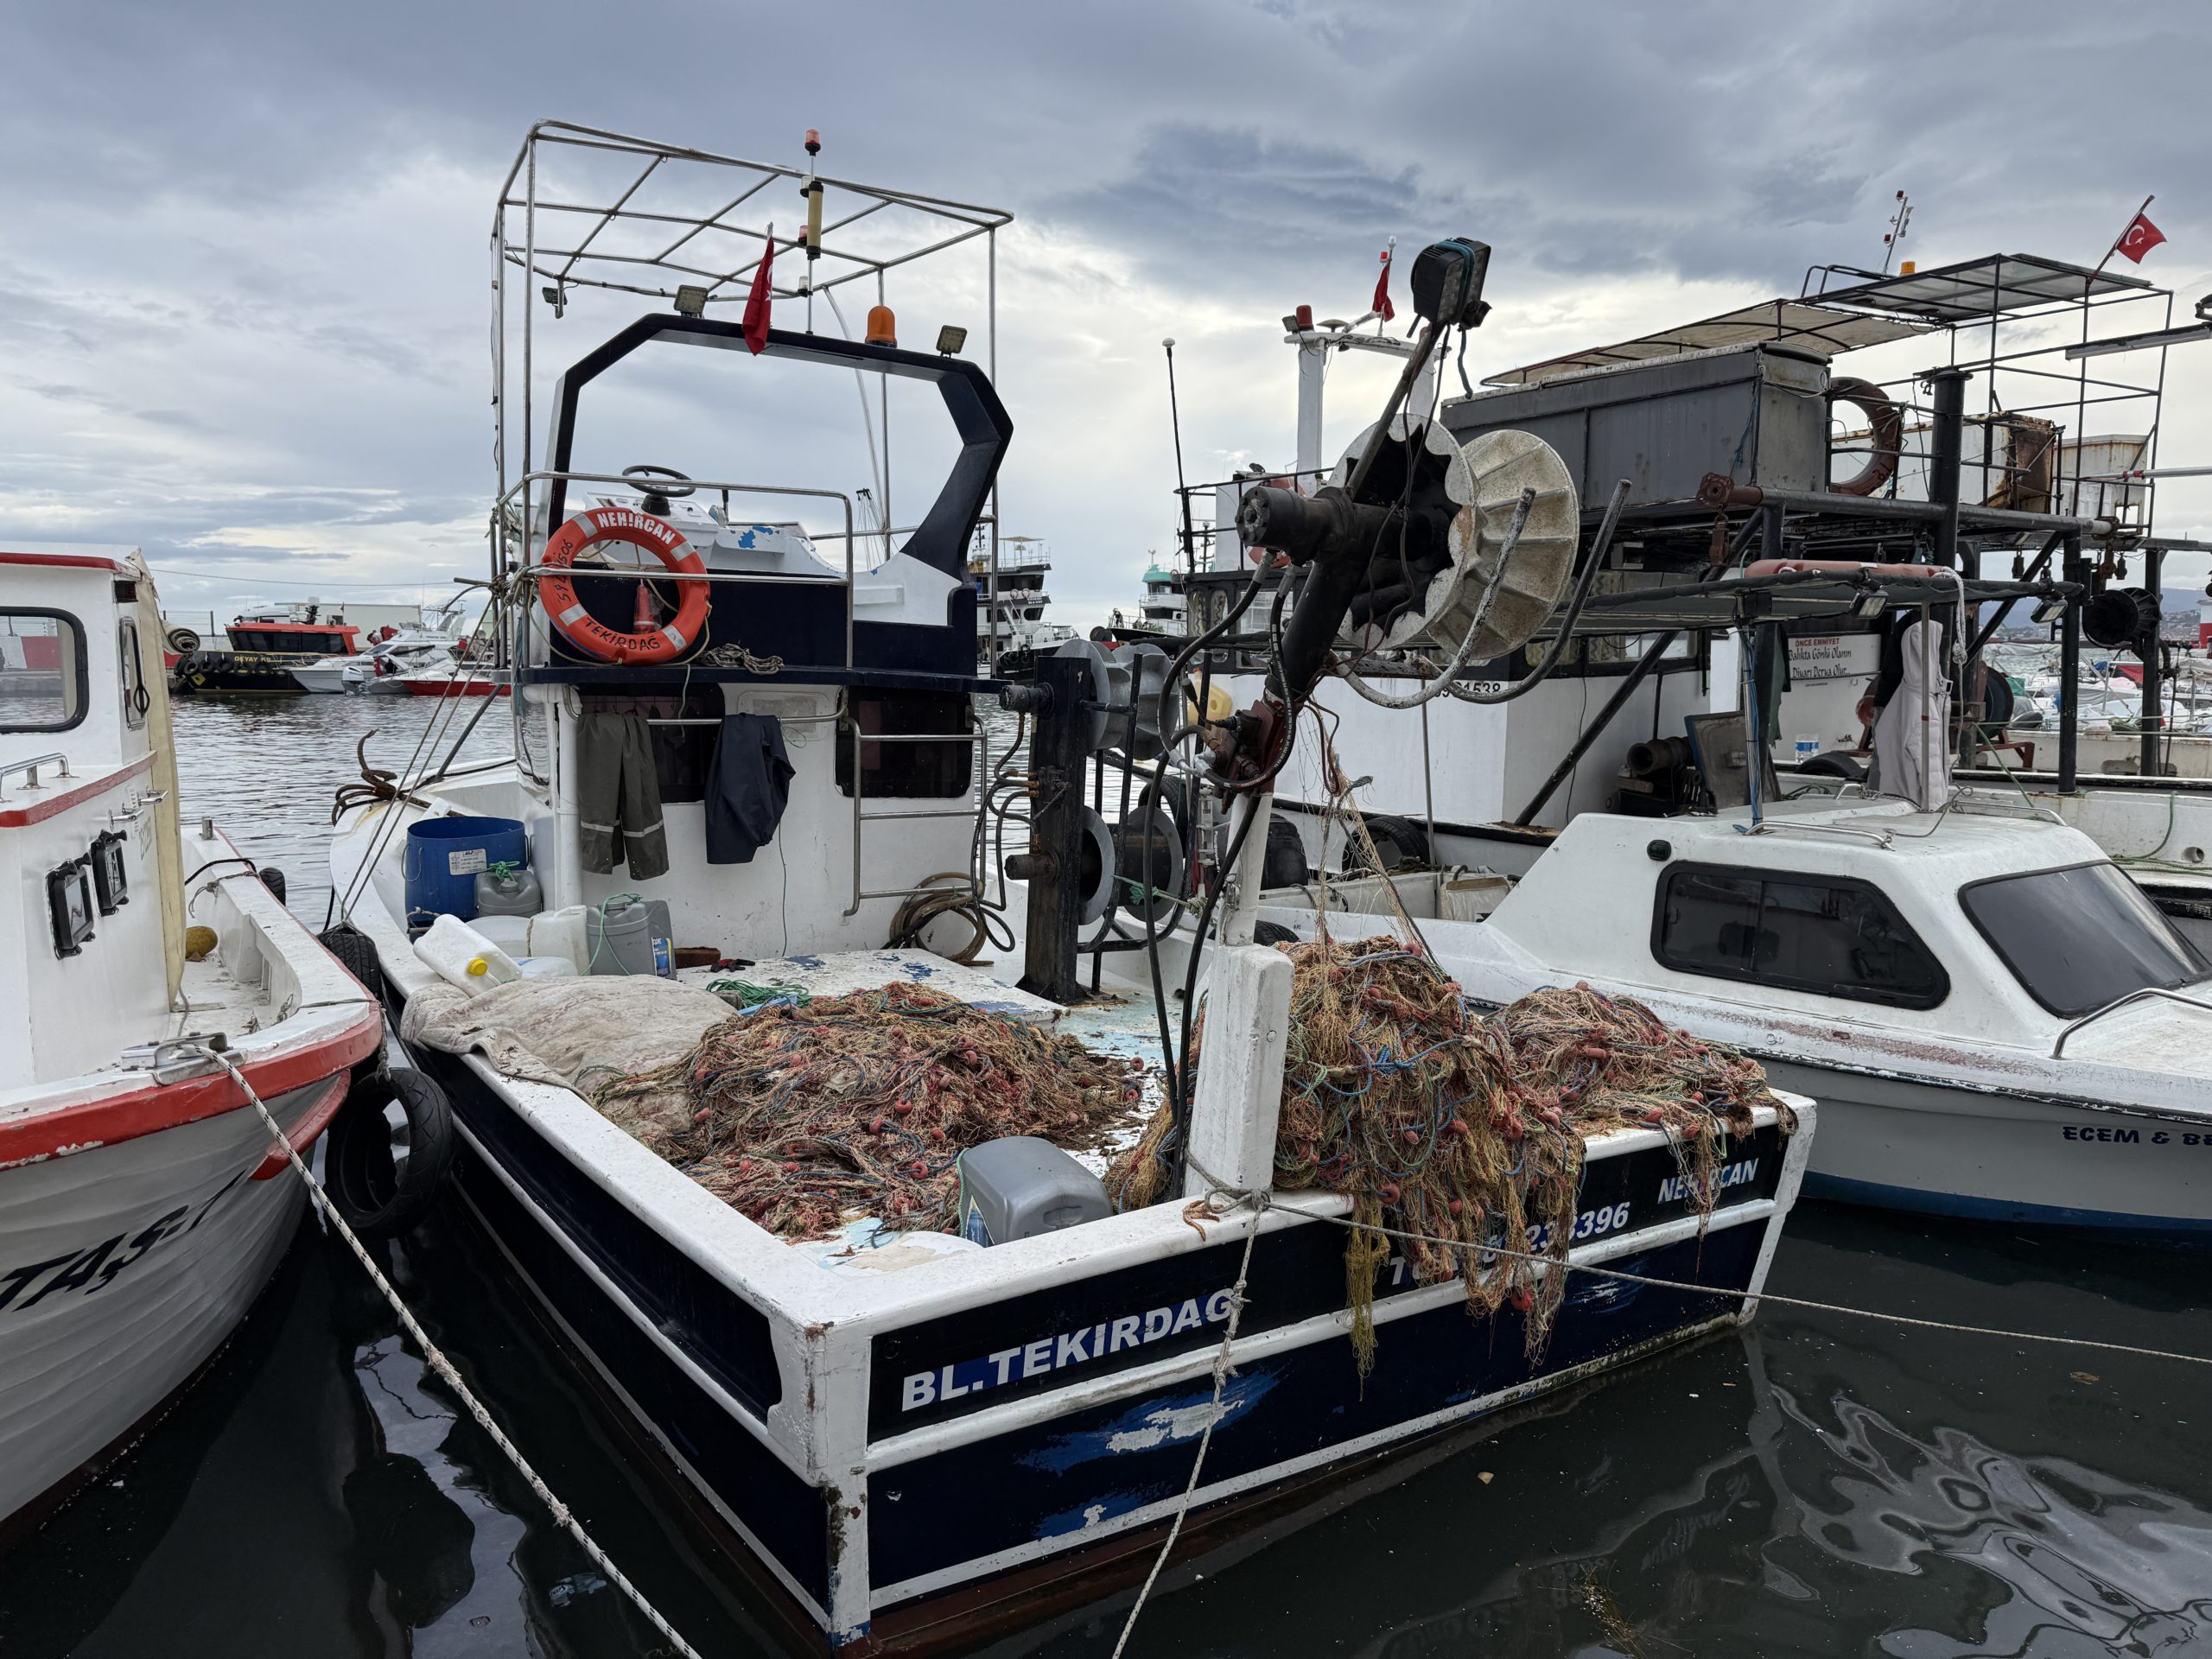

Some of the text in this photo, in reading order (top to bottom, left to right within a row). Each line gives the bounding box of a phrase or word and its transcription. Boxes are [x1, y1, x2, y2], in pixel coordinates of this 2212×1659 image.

[1796, 637, 1840, 646] ÖNCE EMNİYET
[2063, 1126, 2139, 1143] ECEM
[2152, 1132, 2171, 1144] &
